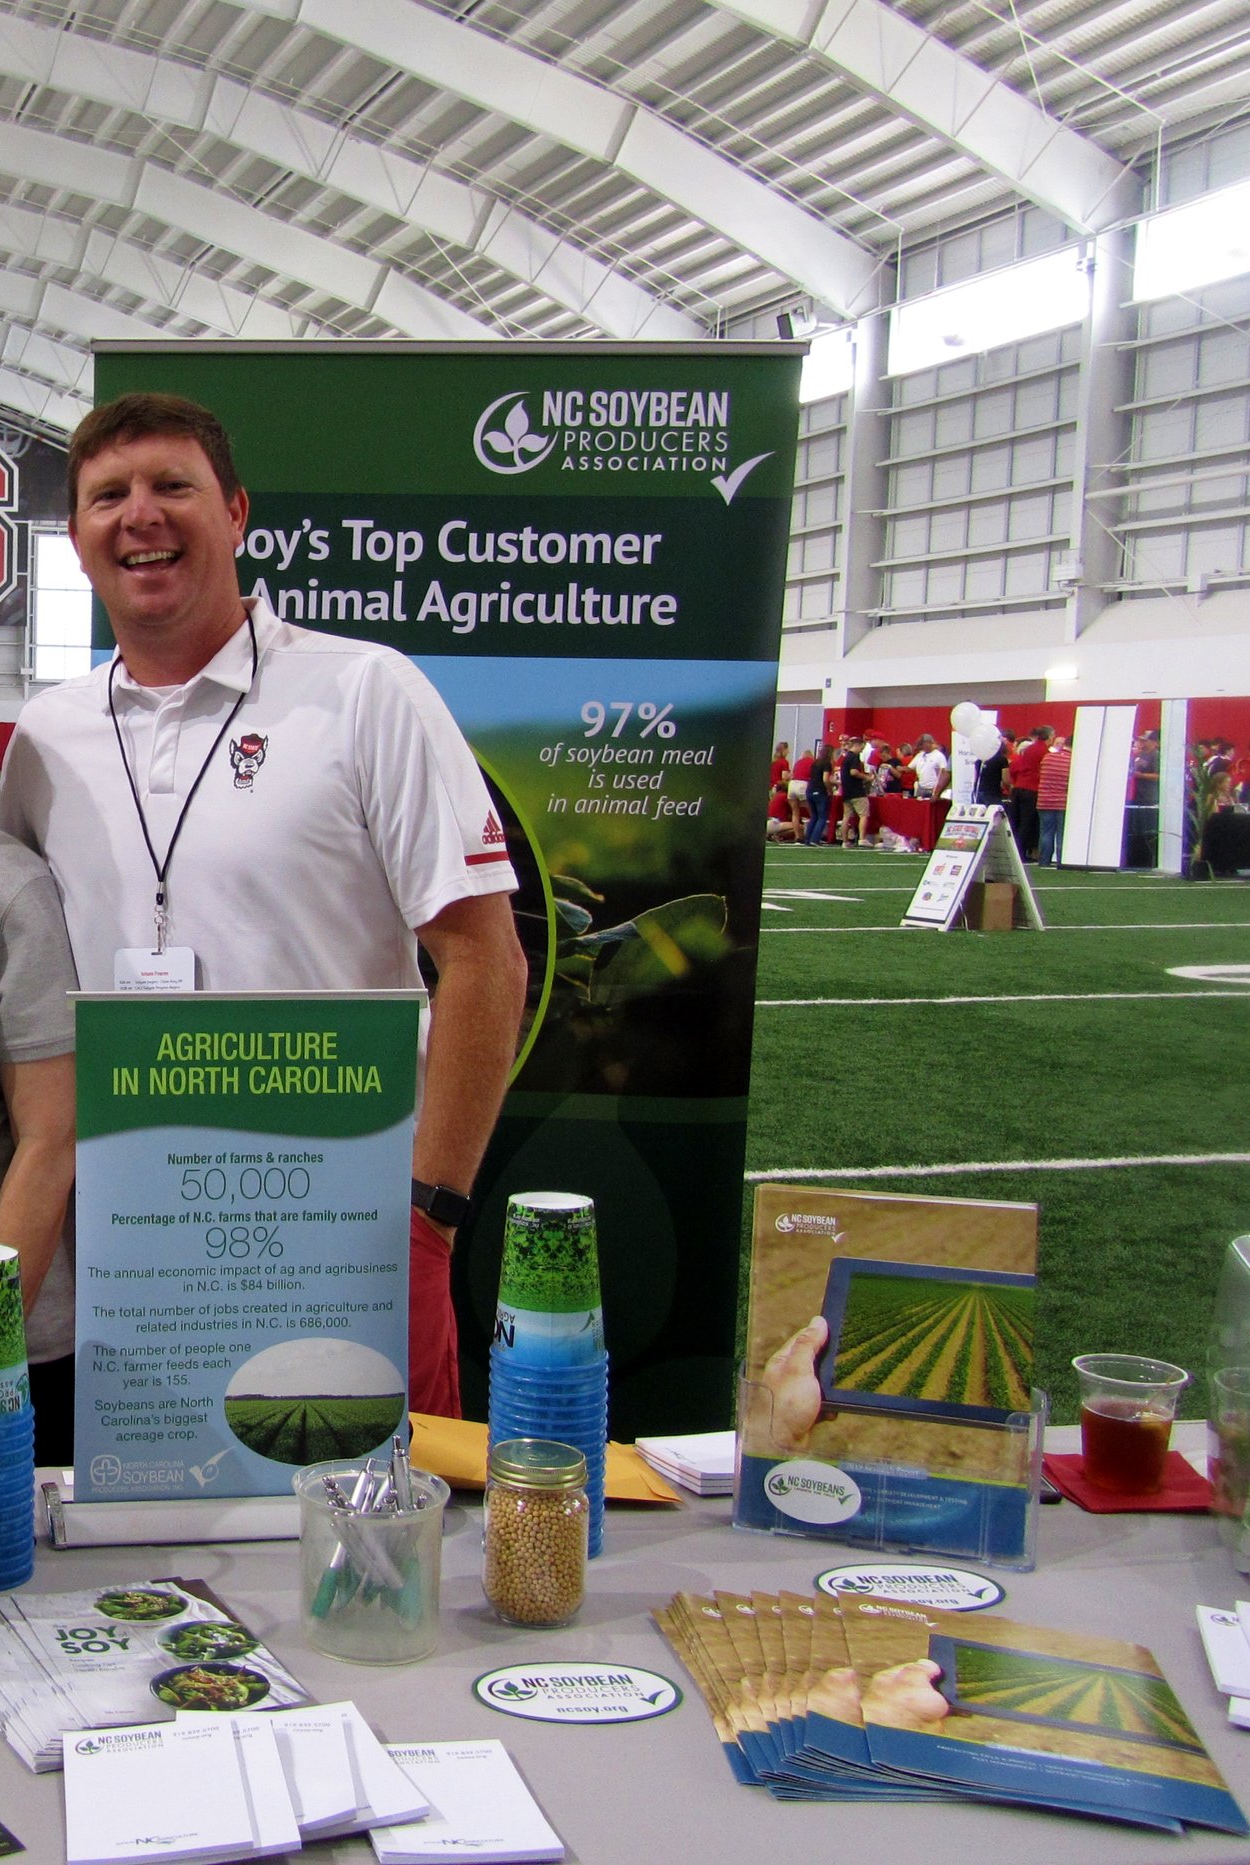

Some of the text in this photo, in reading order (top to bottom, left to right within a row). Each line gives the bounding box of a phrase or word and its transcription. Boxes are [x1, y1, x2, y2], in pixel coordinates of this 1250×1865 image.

[542, 391, 728, 427] NC SOYBEAN
[563, 431, 728, 452] PRODUCERS
[561, 456, 727, 472] ASSOCIATION
[342, 519, 423, 572] Top
[438, 520, 662, 565] Customer
[249, 578, 677, 634] Animal Agriculture
[580, 701, 676, 740] 97%
[539, 743, 713, 768] of soybean meal
[588, 770, 662, 790] is used
[548, 795, 701, 819] in animal feed
[156, 1032, 338, 1061] AGRICULTURE
[113, 1066, 382, 1095] IN NORTH CAROLINA
[167, 1152, 324, 1166] Number of farms & ranches
[180, 1167, 310, 1204] 50,000
[111, 1210, 378, 1226] Percentage of N.C. farms that are family owned
[792, 1214, 836, 1225] NC SOYBEAN
[796, 1223, 836, 1231] PRODUCERS
[205, 1226, 284, 1259] 98%
[87, 1262, 398, 1279] The annual economic impact of ag and agribusiness
[183, 1279, 305, 1292] in N.C. is $84 billion.
[92, 1300, 393, 1318] The total number of jobs created in agriculture and
[136, 1317, 351, 1333] related industries in N.C. is 686,000.
[93, 1343, 251, 1357] The number of people one
[93, 1358, 231, 1372] N.C. farmer feeds each
[122, 1375, 191, 1390] year is 155.
[94, 1397, 214, 1413] Soybeans are North
[101, 1412, 208, 1427] Carolina's biggest
[116, 1430, 198, 1443] acreage crop.
[123, 1470, 184, 1484] SOYBEAN
[787, 1476, 845, 1495] NC SOYBEANS
[856, 1574, 959, 1584] NC SOYBEAN
[55, 1625, 117, 1641] JOY
[60, 1638, 130, 1654] SOY
[521, 1674, 633, 1688] NC SOYBEAN
[542, 1684, 641, 1695] PRODUCERS
[547, 1692, 644, 1700] ASSOCIATION
[556, 1705, 628, 1714] ncsoy.org
[98, 1731, 162, 1744] NC SOYBEAN
[106, 1738, 164, 1748] PRODUCERS
